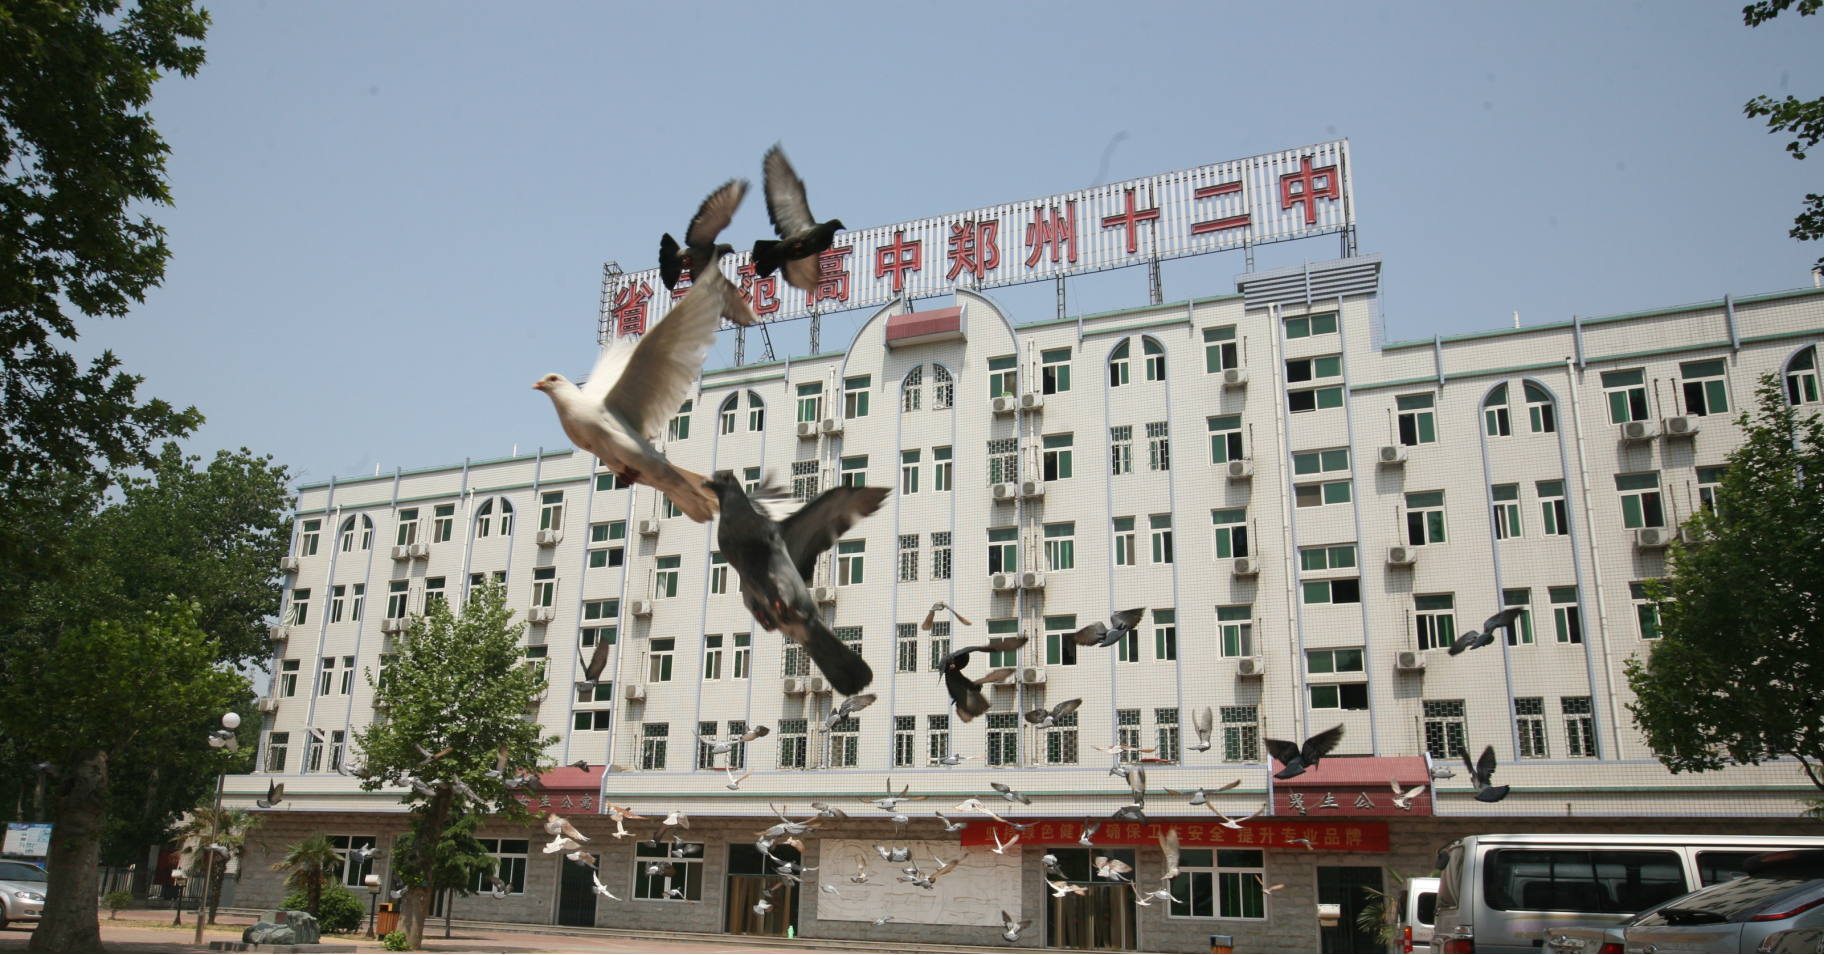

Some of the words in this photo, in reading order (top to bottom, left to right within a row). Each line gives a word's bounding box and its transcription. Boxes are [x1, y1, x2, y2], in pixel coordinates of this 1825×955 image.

[612, 156, 1339, 338] 省范高中郑州十二中
